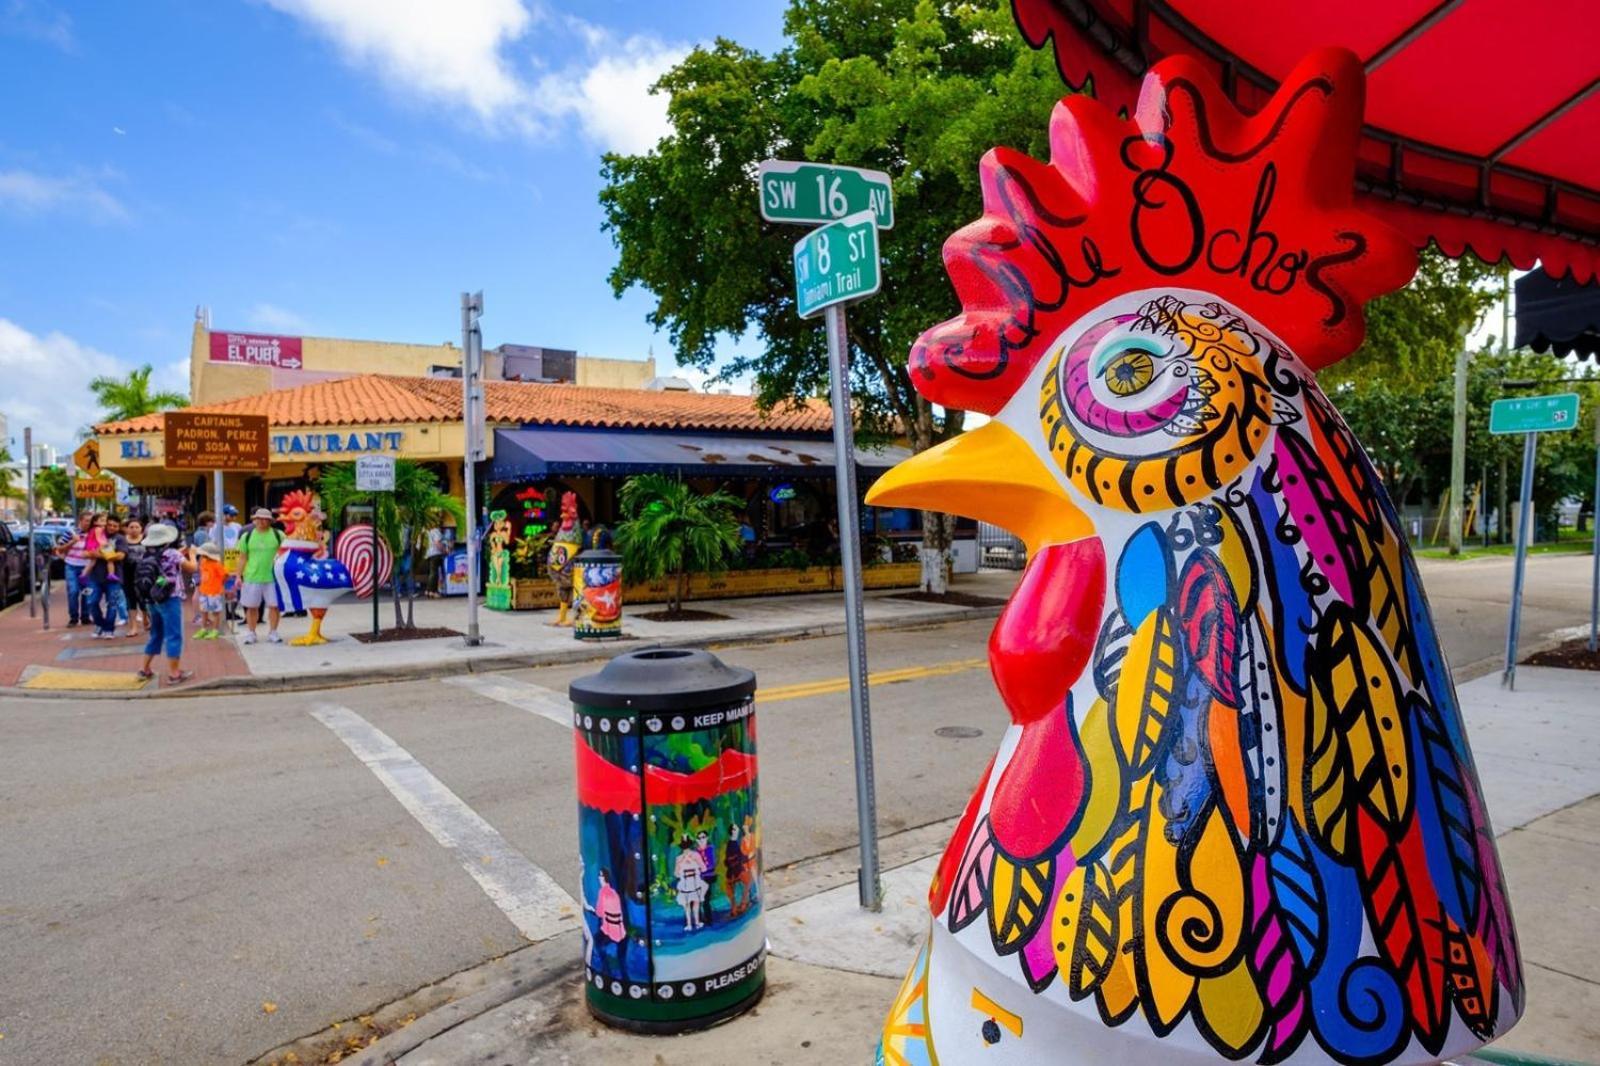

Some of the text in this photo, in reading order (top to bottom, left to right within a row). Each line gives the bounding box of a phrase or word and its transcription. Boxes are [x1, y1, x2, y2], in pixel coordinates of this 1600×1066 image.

[767, 174, 886, 217] SW 16 AV
[817, 232, 831, 275] 8
[848, 229, 866, 262] ST
[835, 267, 861, 294] Trail
[228, 345, 244, 360] EL
[120, 432, 402, 458] EL TAURANT
[226, 430, 258, 440] PEREZ
[177, 441, 258, 452] AND SOSA WAY
[76, 483, 113, 493] AHEAD
[694, 711, 725, 727] KEEP
[705, 966, 747, 991] PLEASE
[747, 958, 759, 974] DO
